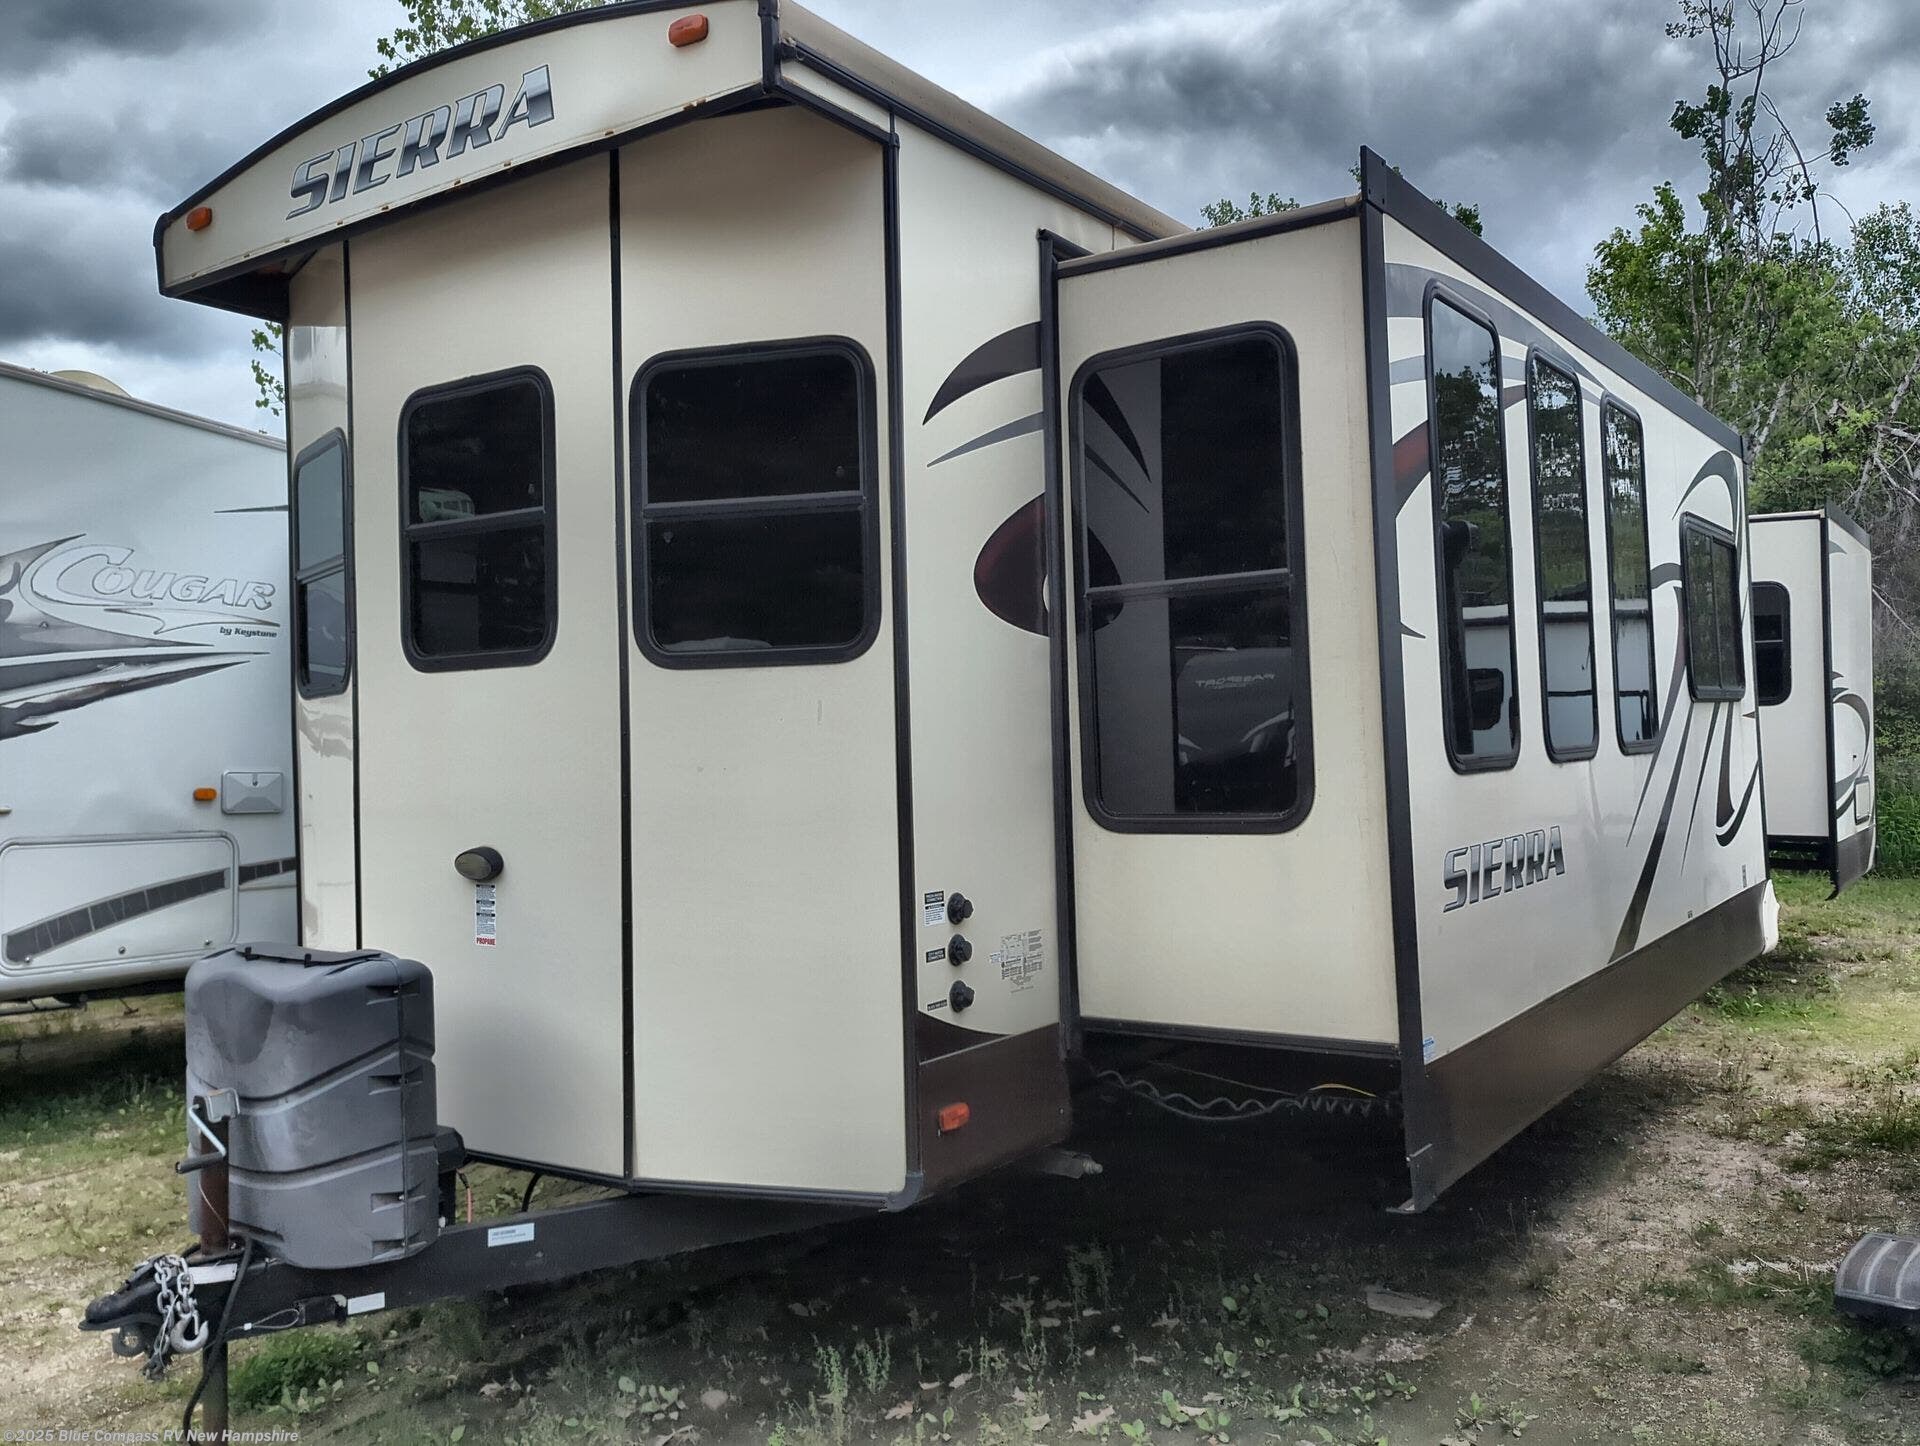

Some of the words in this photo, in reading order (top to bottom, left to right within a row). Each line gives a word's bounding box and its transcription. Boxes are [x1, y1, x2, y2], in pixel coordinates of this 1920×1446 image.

[286, 64, 555, 220] SIERRA
[220, 626, 232, 635] by
[235, 628, 277, 638] Keystone
[1443, 825, 1565, 913] SIERRA
[476, 937, 496, 945] PROPANE
